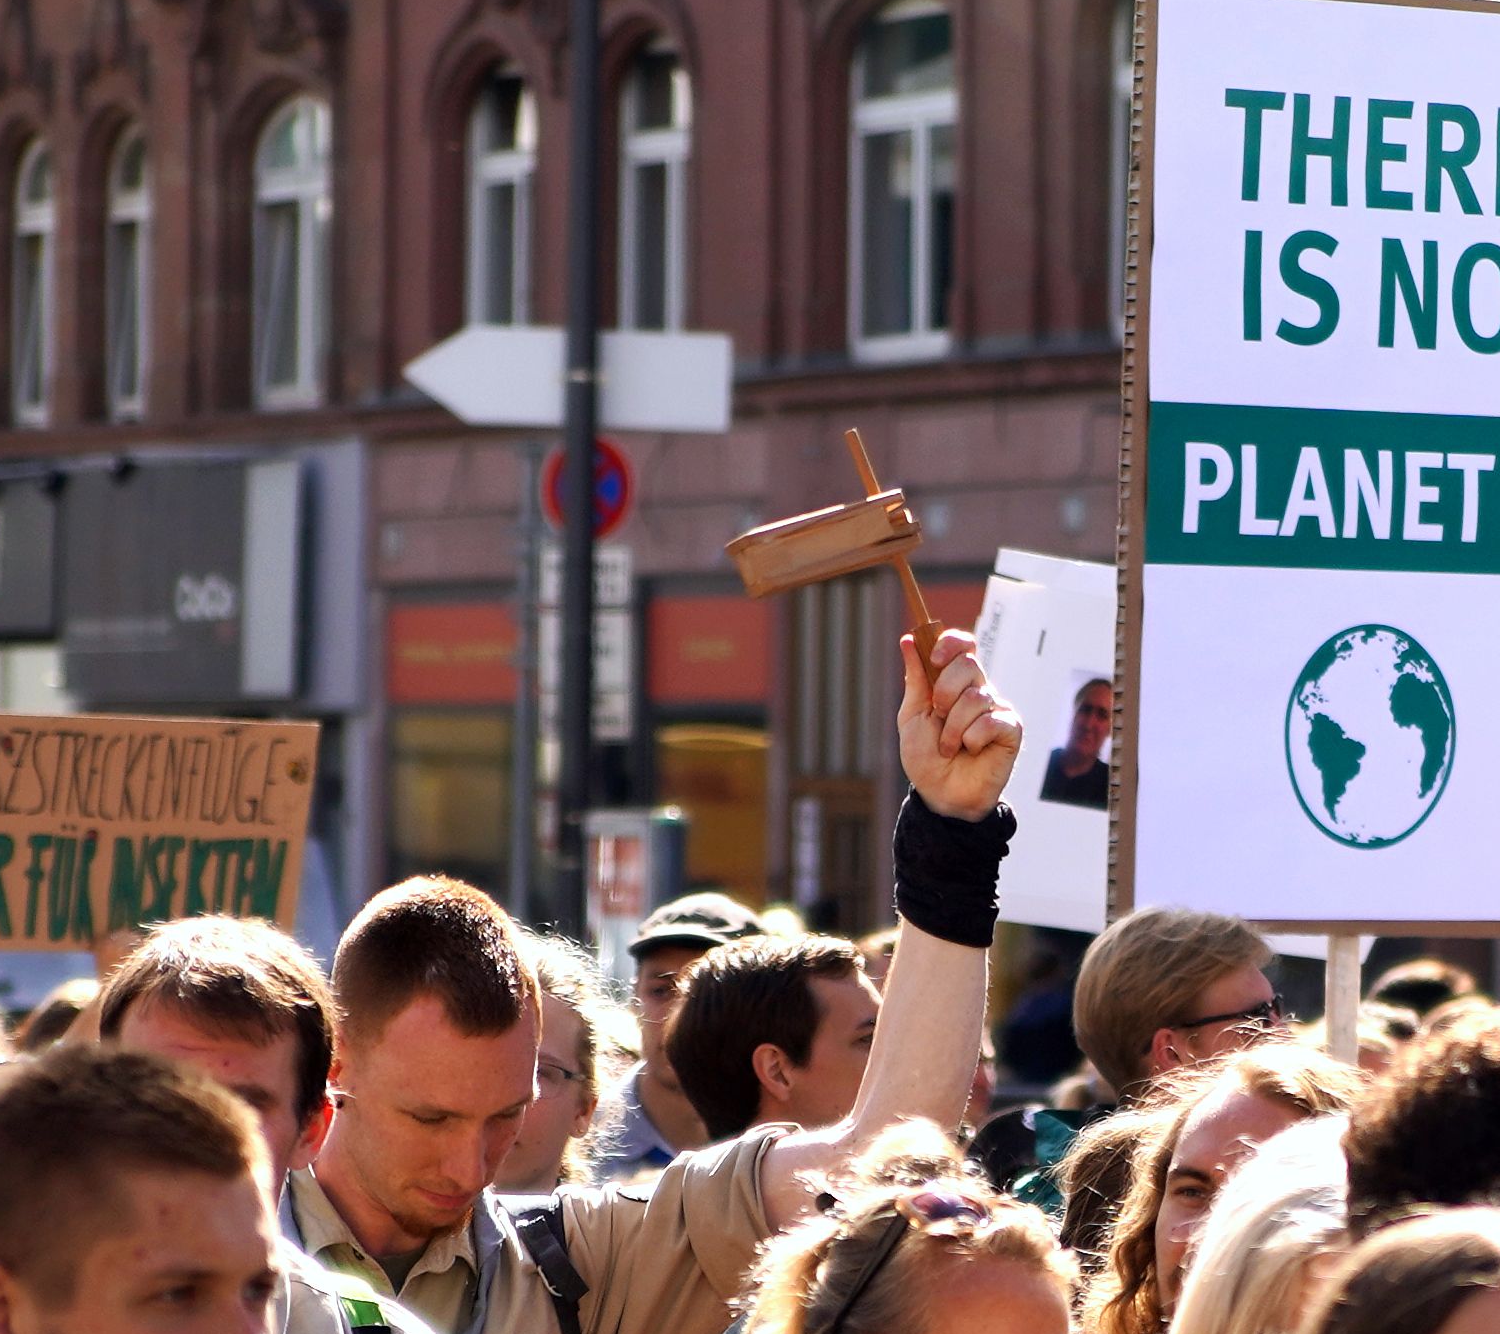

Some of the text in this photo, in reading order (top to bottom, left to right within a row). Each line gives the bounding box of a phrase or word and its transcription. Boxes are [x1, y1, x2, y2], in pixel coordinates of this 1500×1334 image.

[1241, 228, 1340, 346] IS
[1181, 441, 1497, 543] PLANET
[25, 824, 99, 942] FÜR
